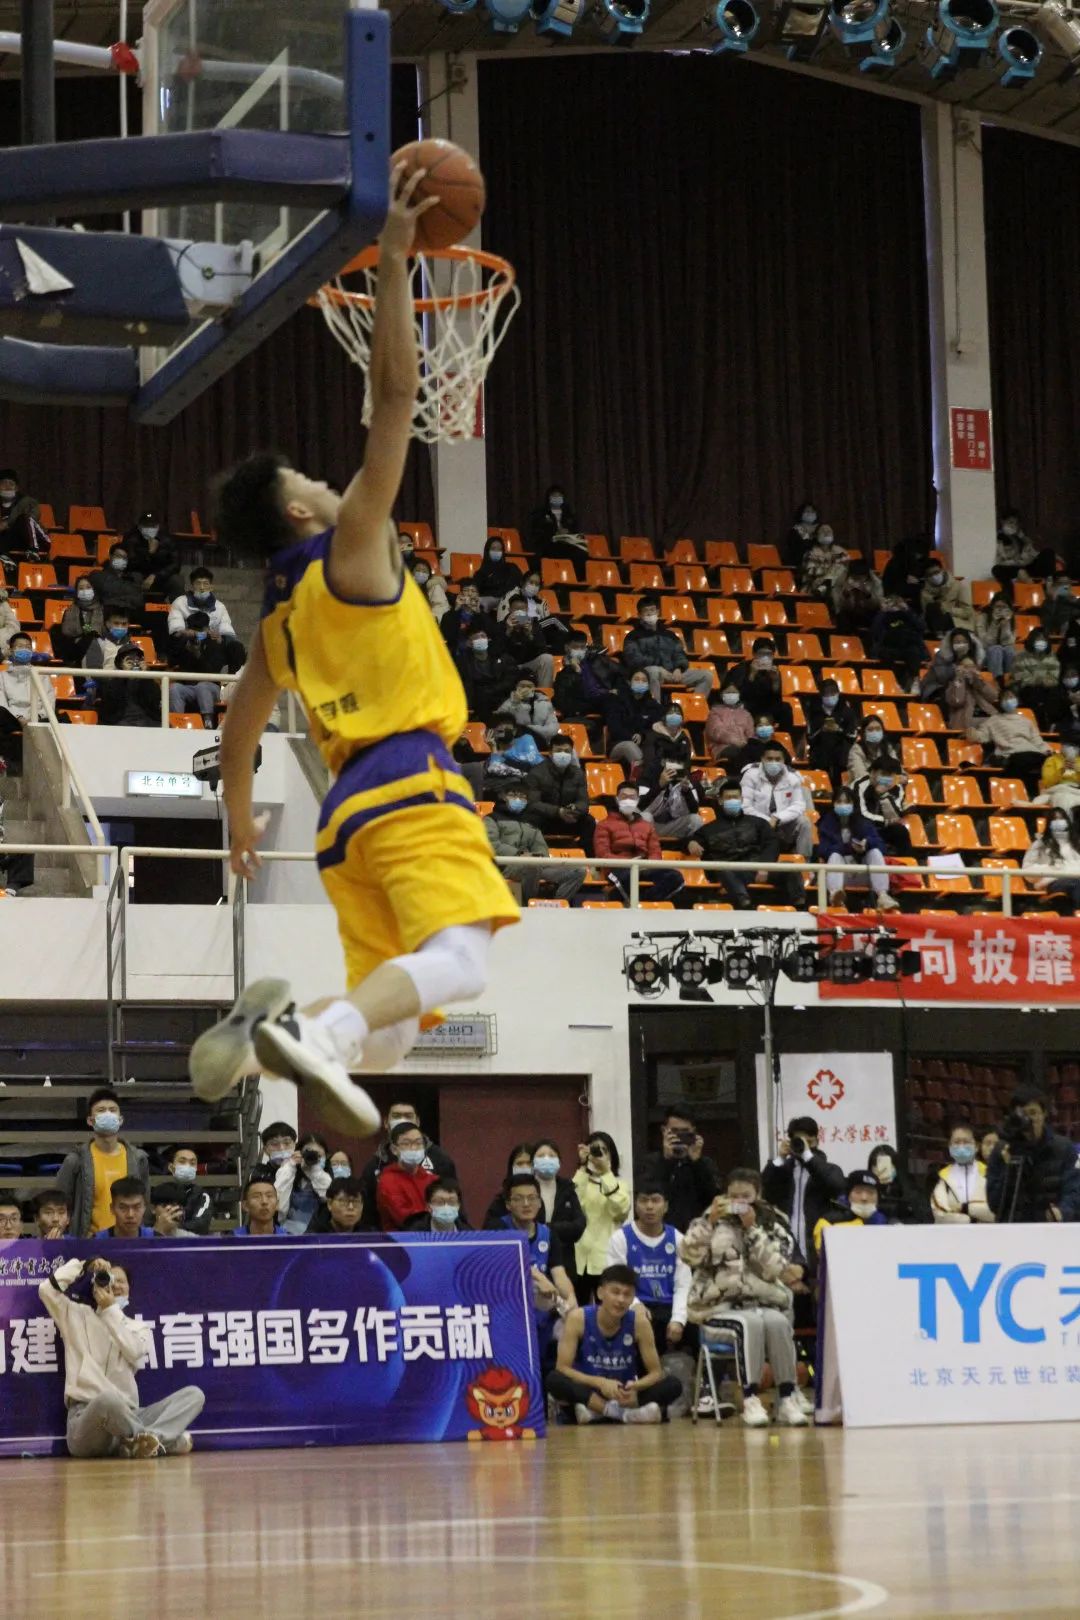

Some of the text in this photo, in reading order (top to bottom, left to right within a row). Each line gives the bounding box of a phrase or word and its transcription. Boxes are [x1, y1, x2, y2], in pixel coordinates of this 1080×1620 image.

[852, 929, 1075, 985] 向披靡
[898, 1262, 1046, 1344] TYC
[909, 1365, 1080, 1386] 北京天元世纪装
